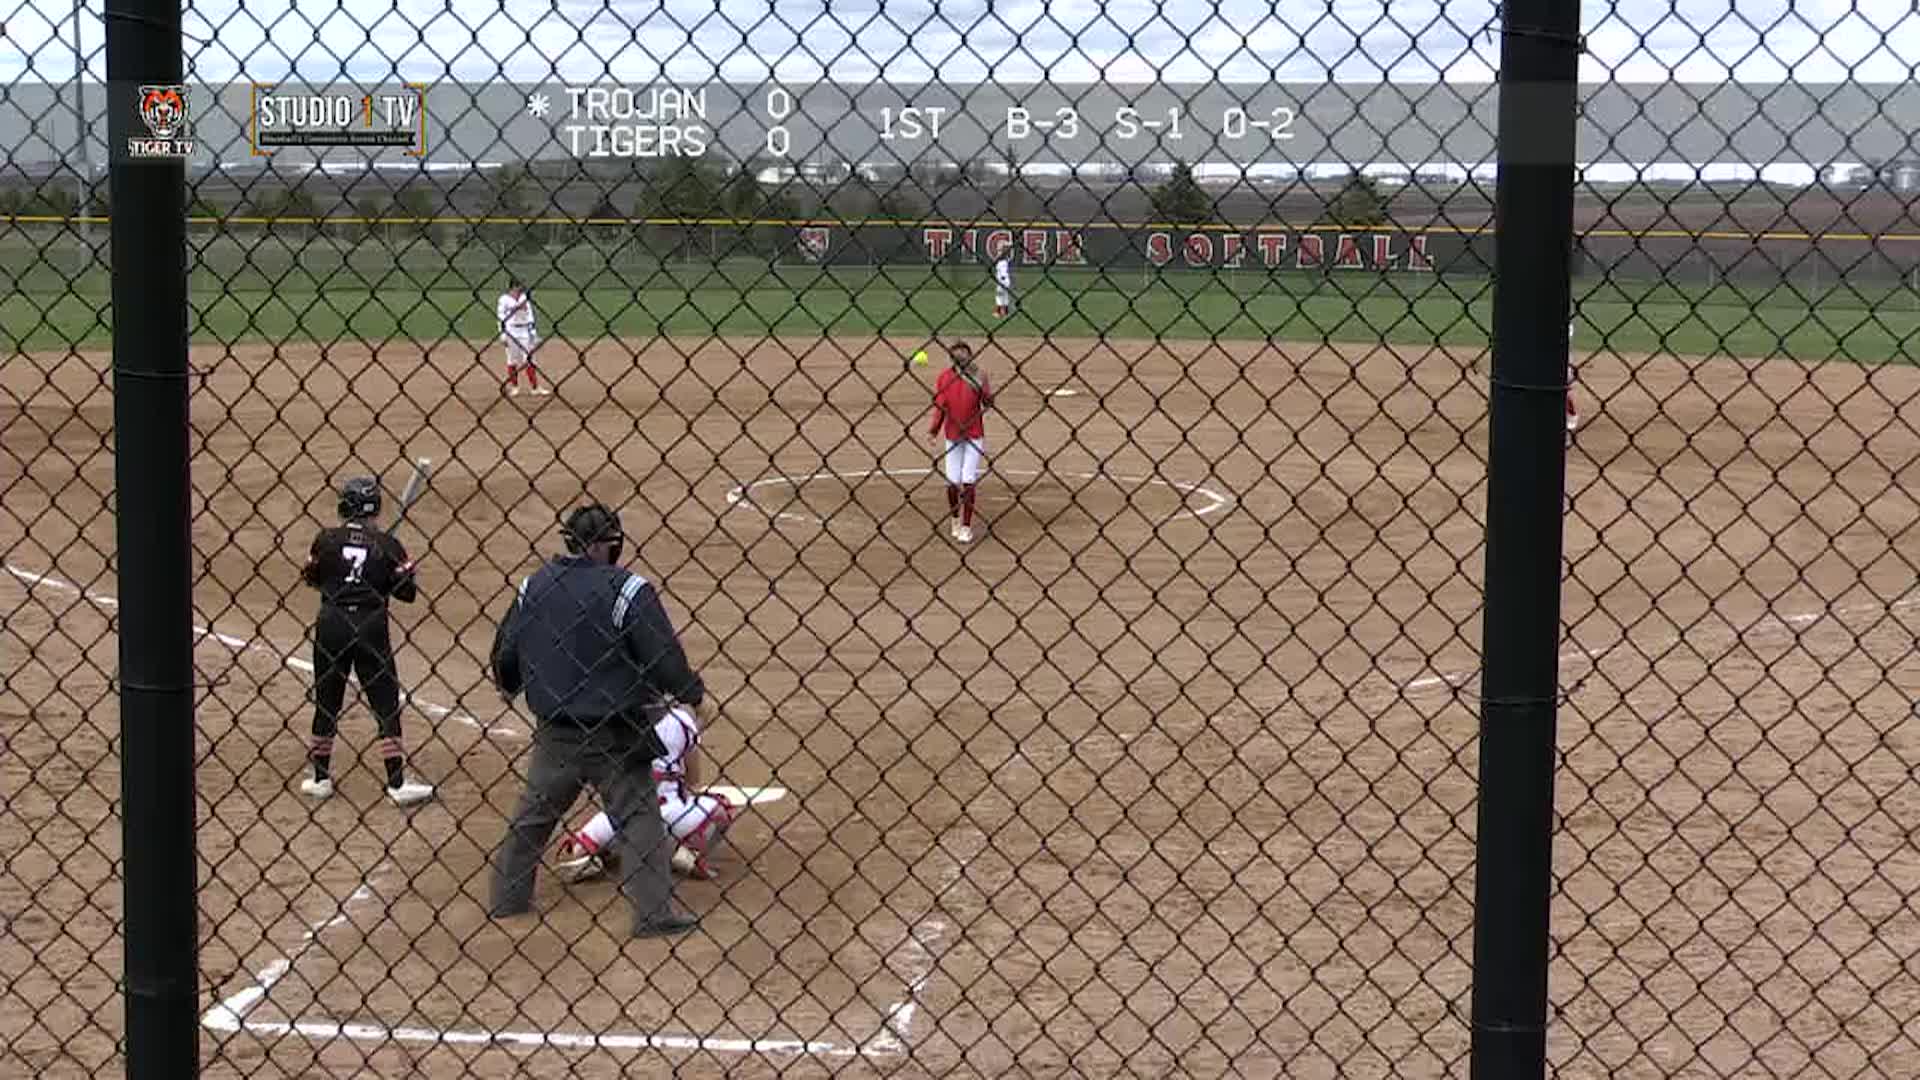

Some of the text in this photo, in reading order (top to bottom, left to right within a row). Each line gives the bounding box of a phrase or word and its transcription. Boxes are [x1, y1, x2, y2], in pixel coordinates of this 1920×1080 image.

[924, 229, 1434, 271] TIGER SOFTBALL
[342, 546, 368, 583] 7
